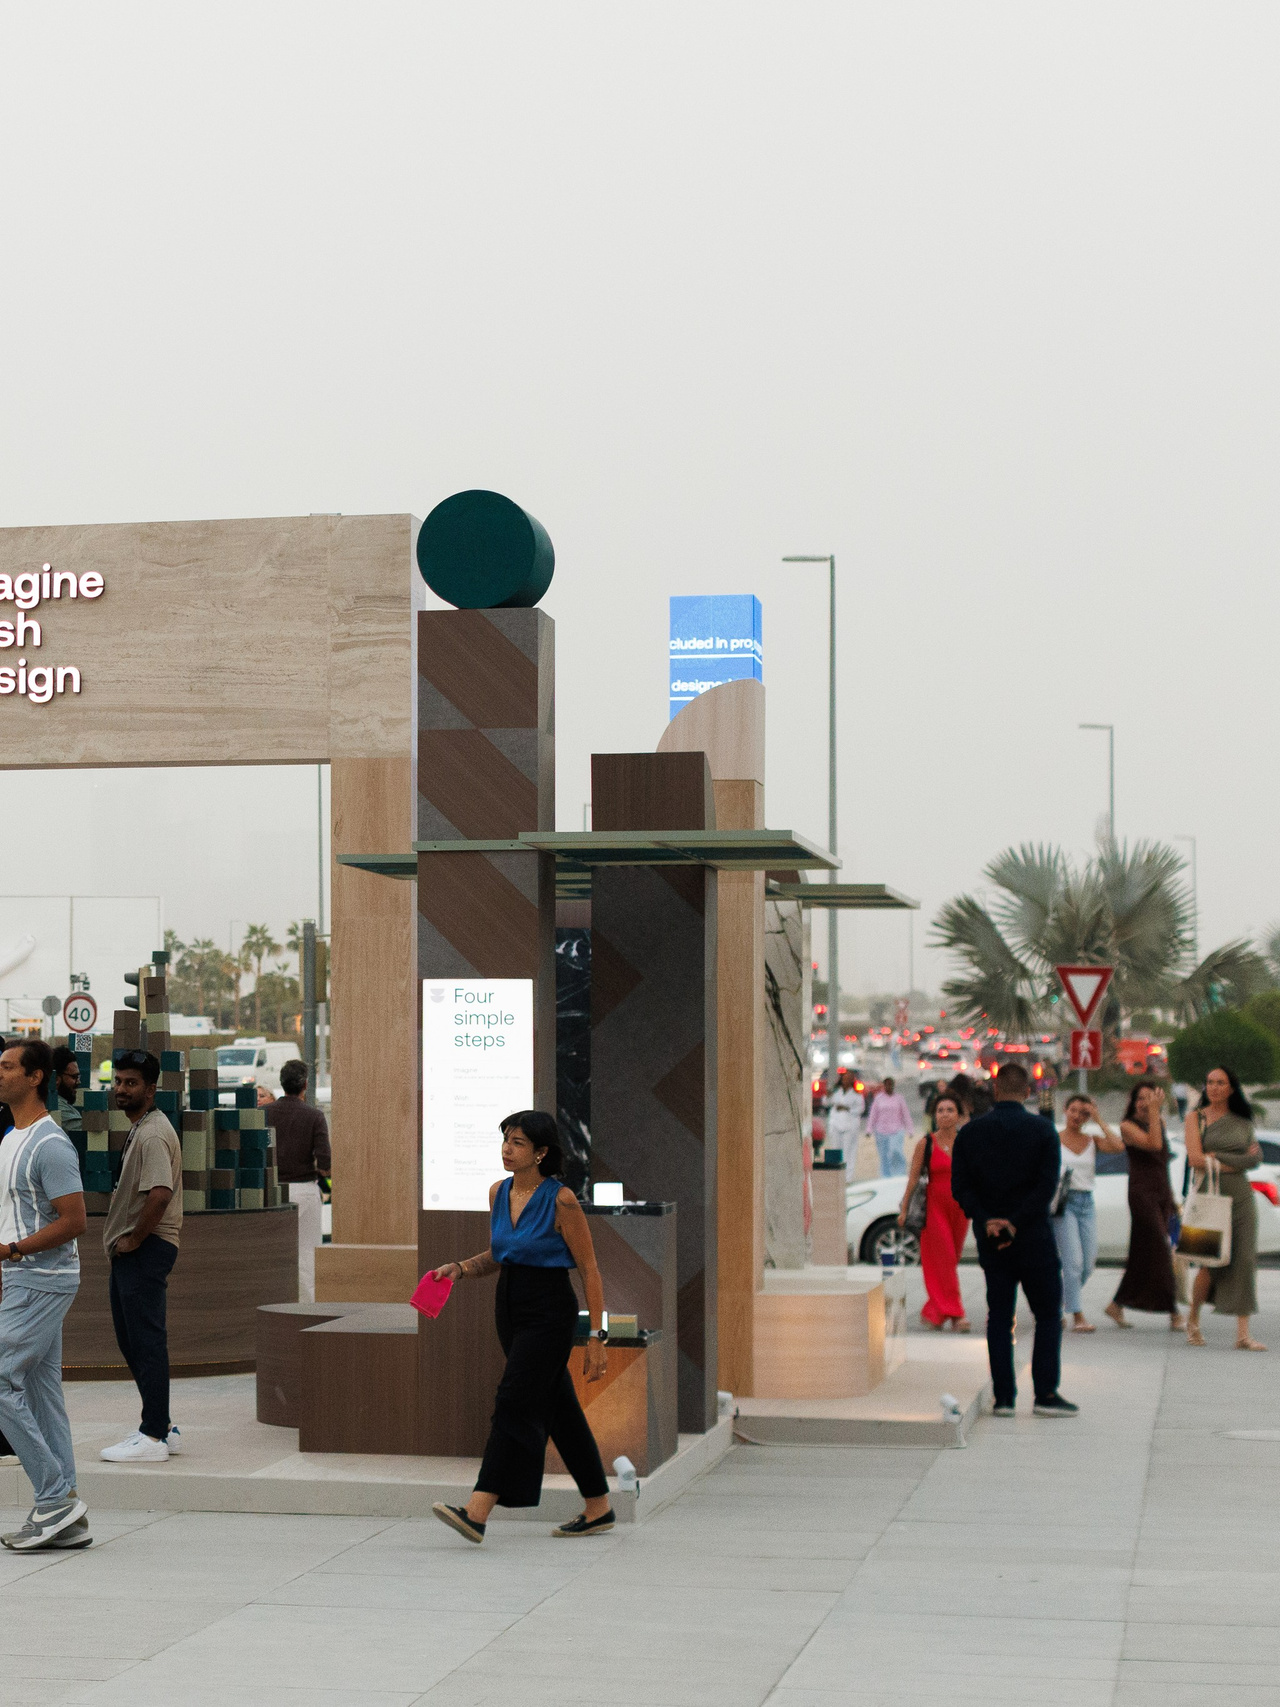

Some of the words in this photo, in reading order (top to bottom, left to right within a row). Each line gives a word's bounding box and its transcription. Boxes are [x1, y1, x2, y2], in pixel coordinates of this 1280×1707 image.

[716, 637, 728, 649] in
[454, 988, 495, 1004] Four
[68, 1007, 91, 1022] 40
[454, 1010, 515, 1029] simple
[454, 1032, 506, 1050] steps
